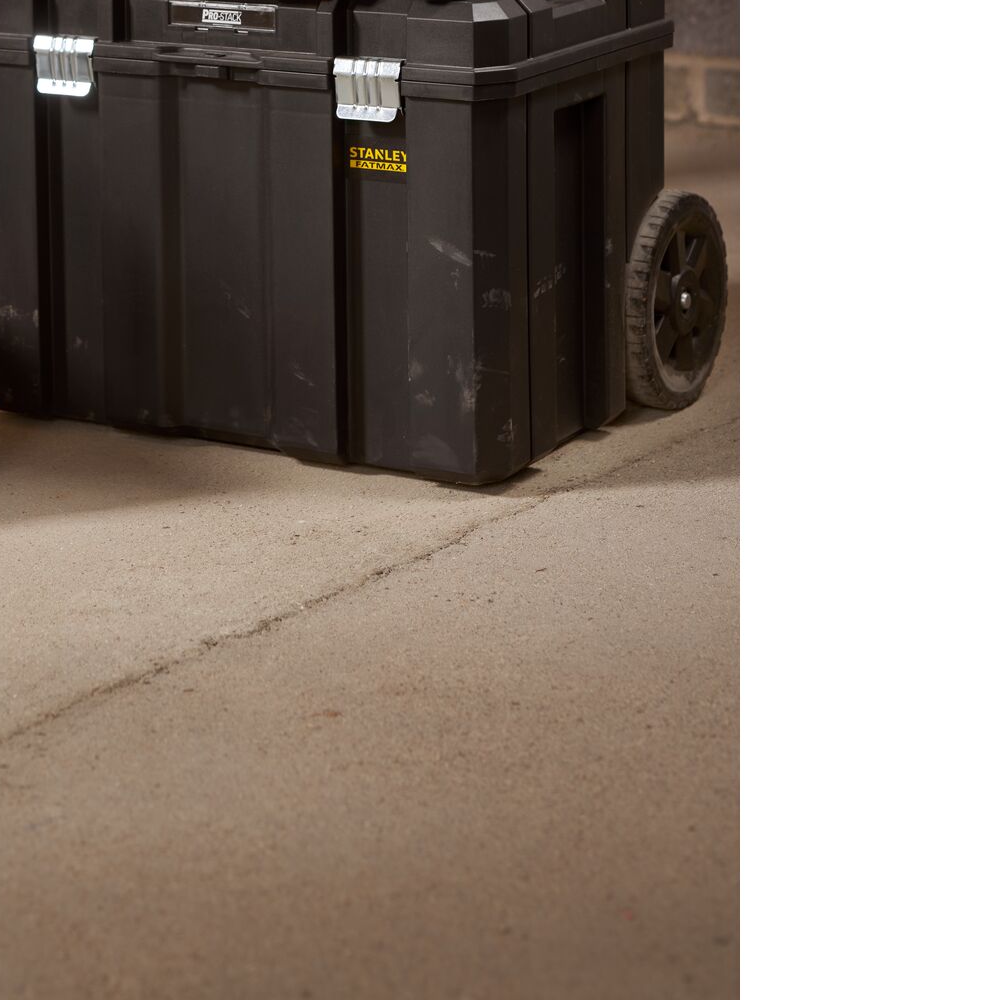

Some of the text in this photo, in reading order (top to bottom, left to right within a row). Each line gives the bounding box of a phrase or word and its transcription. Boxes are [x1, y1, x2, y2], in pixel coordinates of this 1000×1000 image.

[202, 8, 243, 23] PRO-STACK
[349, 146, 407, 162] STANLEY
[356, 161, 402, 171] FATMAX
